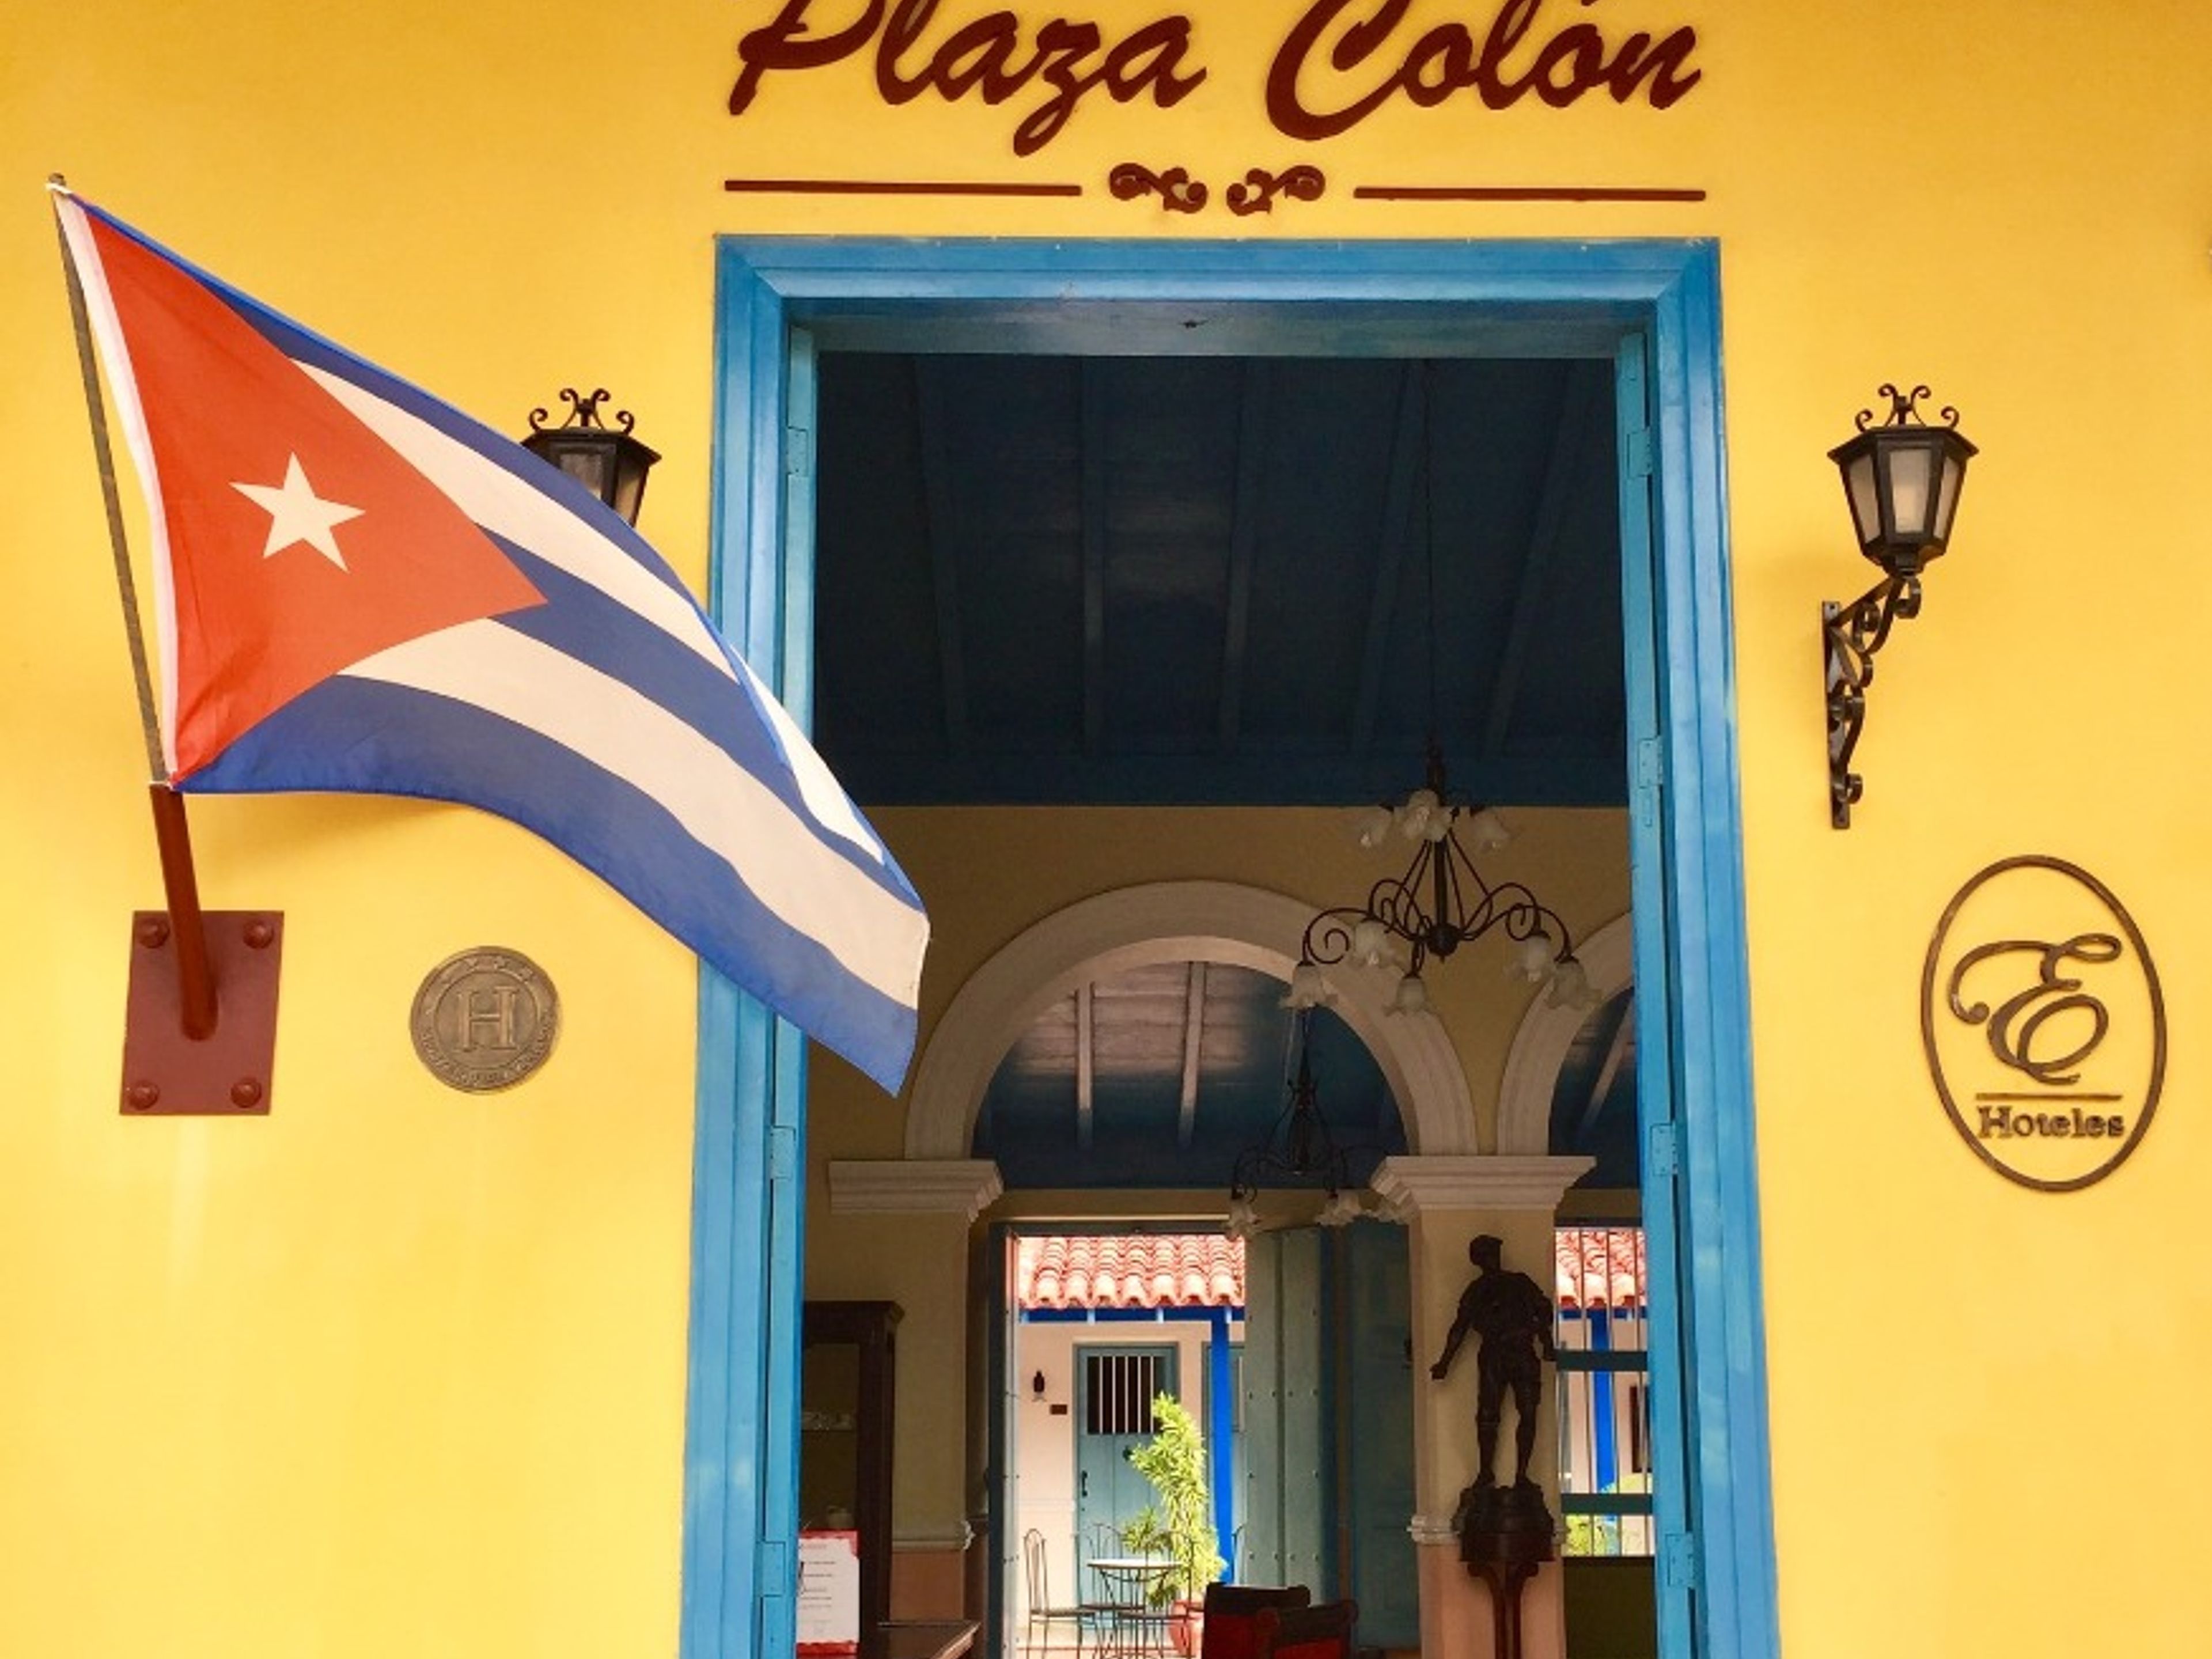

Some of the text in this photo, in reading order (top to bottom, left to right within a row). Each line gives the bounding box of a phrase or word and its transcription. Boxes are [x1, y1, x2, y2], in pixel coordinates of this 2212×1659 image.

[728, 0, 1207, 157] Plaza
[454, 985, 520, 1052] H
[1948, 933, 2123, 1085] E
[1976, 1106, 2125, 1139] Hoteles
